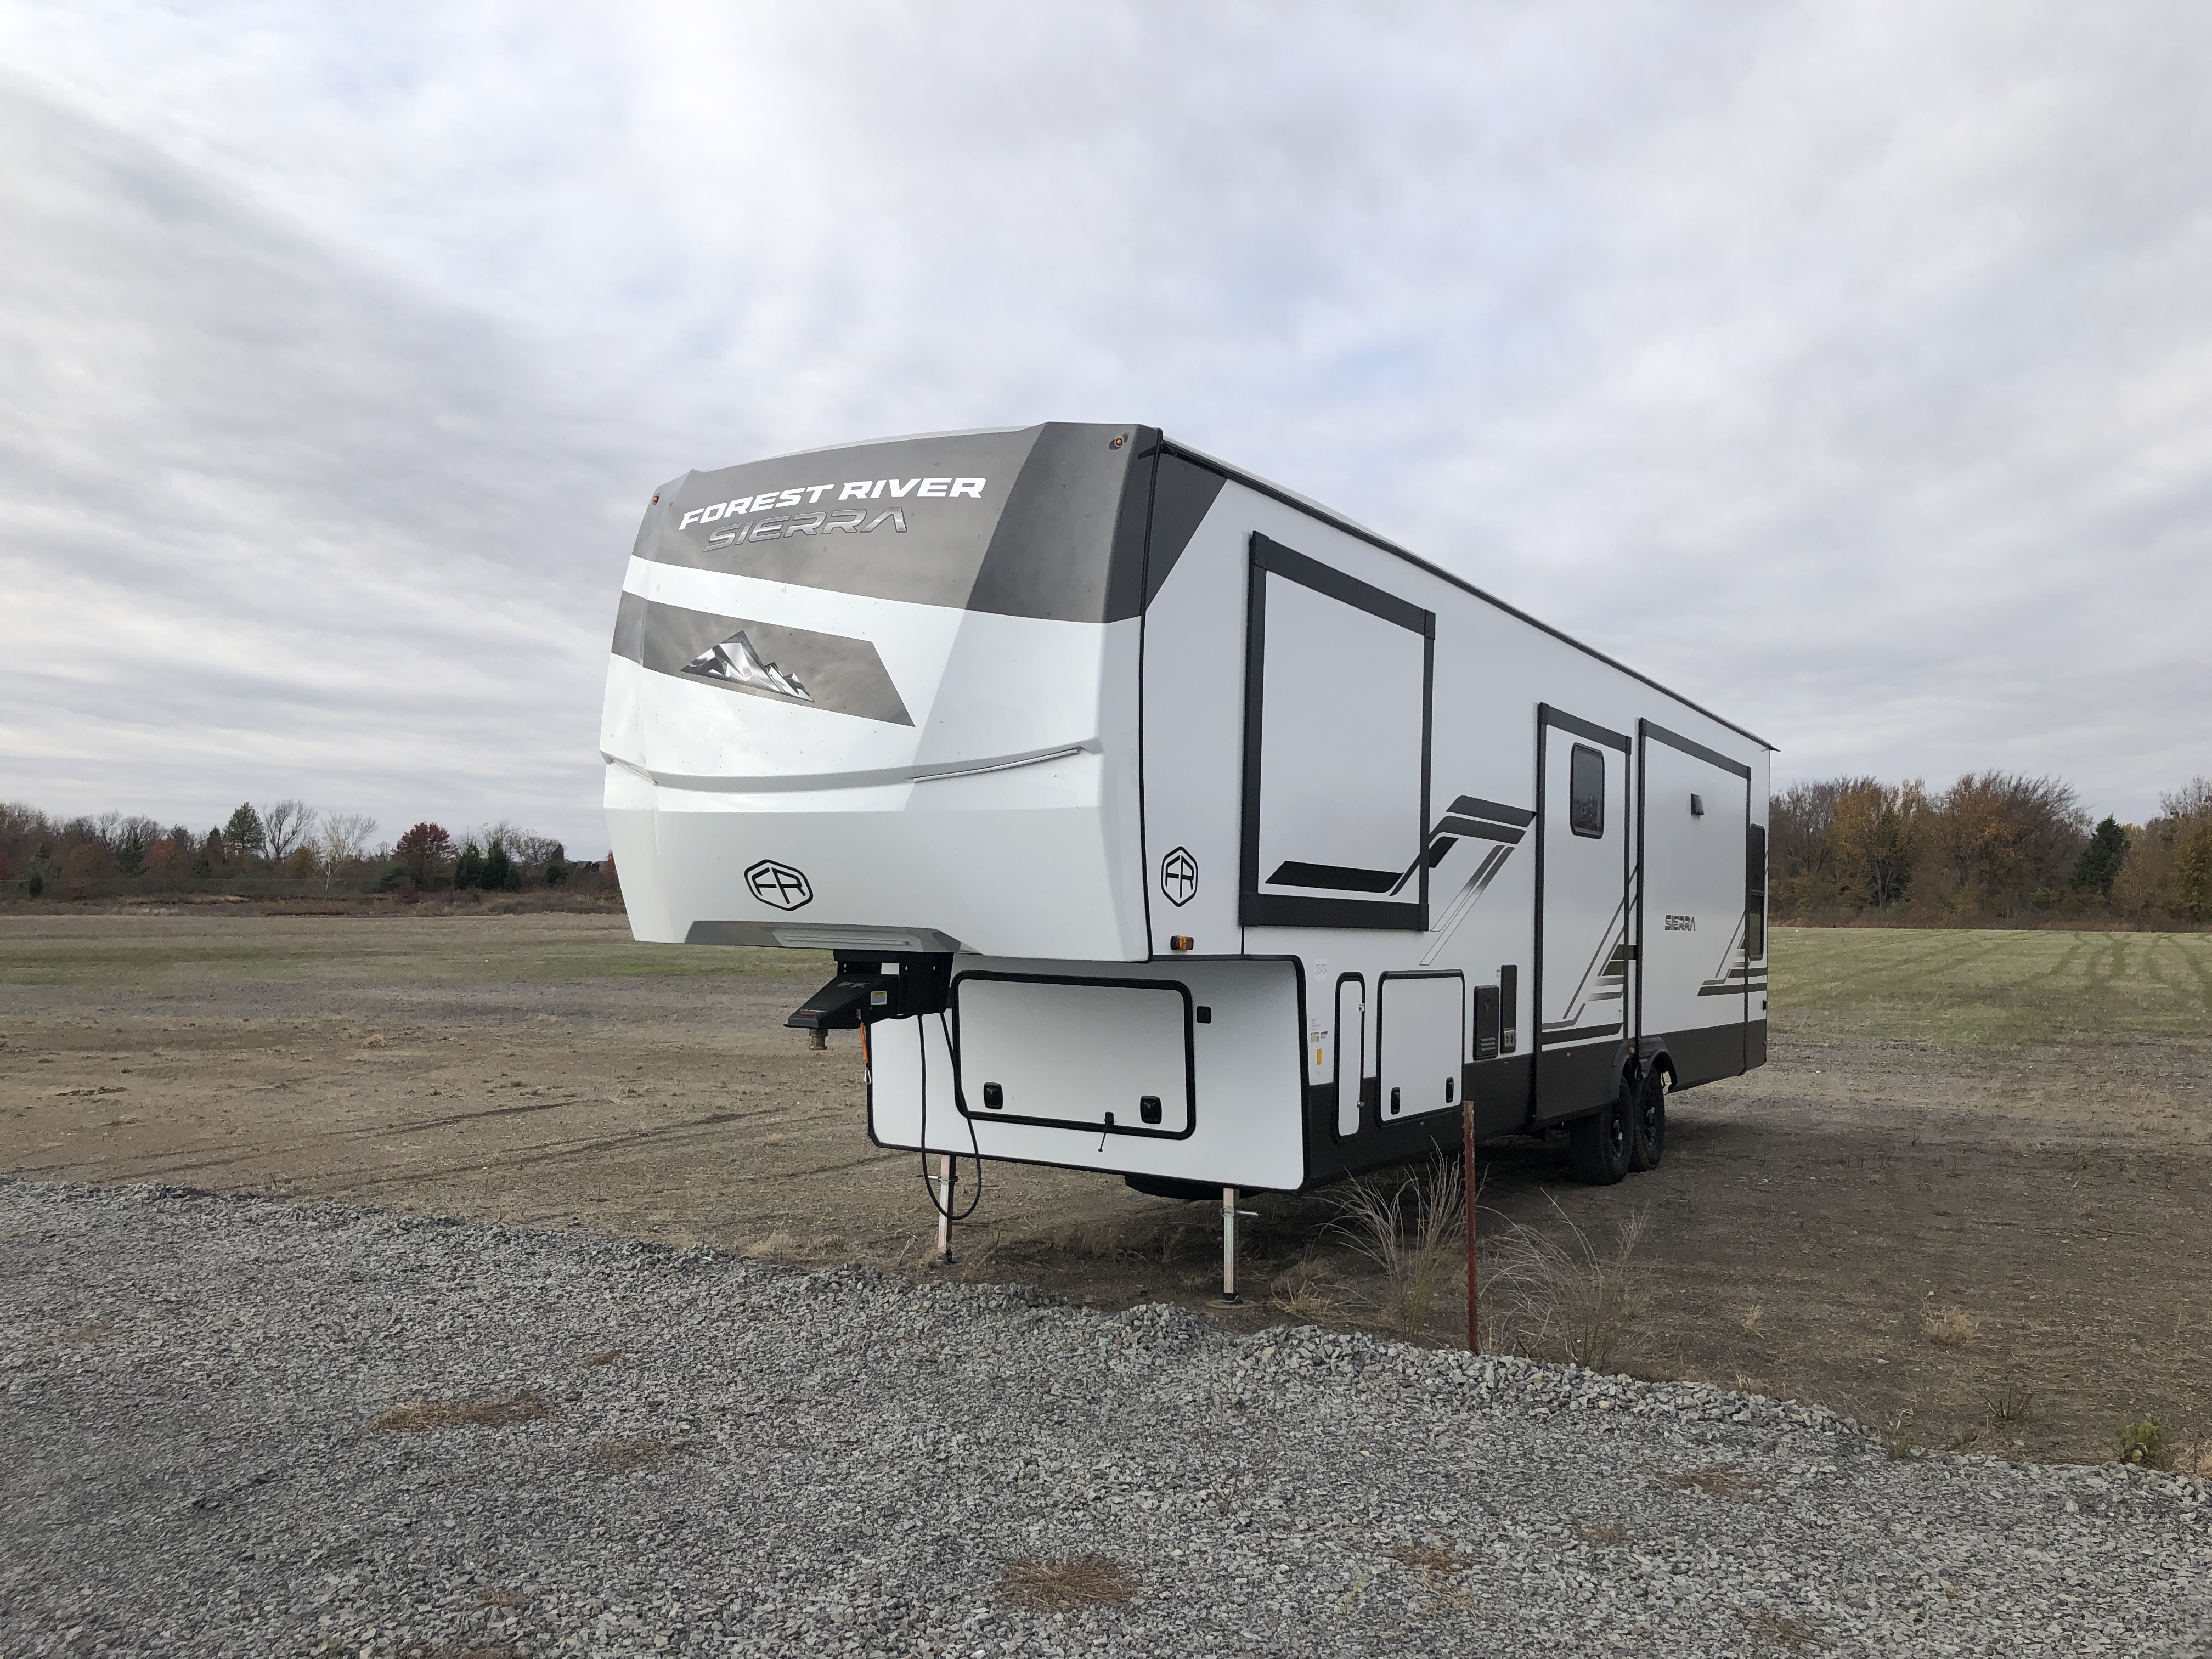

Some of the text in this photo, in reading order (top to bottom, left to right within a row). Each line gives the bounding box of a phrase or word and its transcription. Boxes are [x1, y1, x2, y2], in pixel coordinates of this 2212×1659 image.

[679, 478, 986, 530] FOREST RIVER
[703, 507, 907, 552] SIERRA
[1665, 915, 1696, 931] SIERRA
